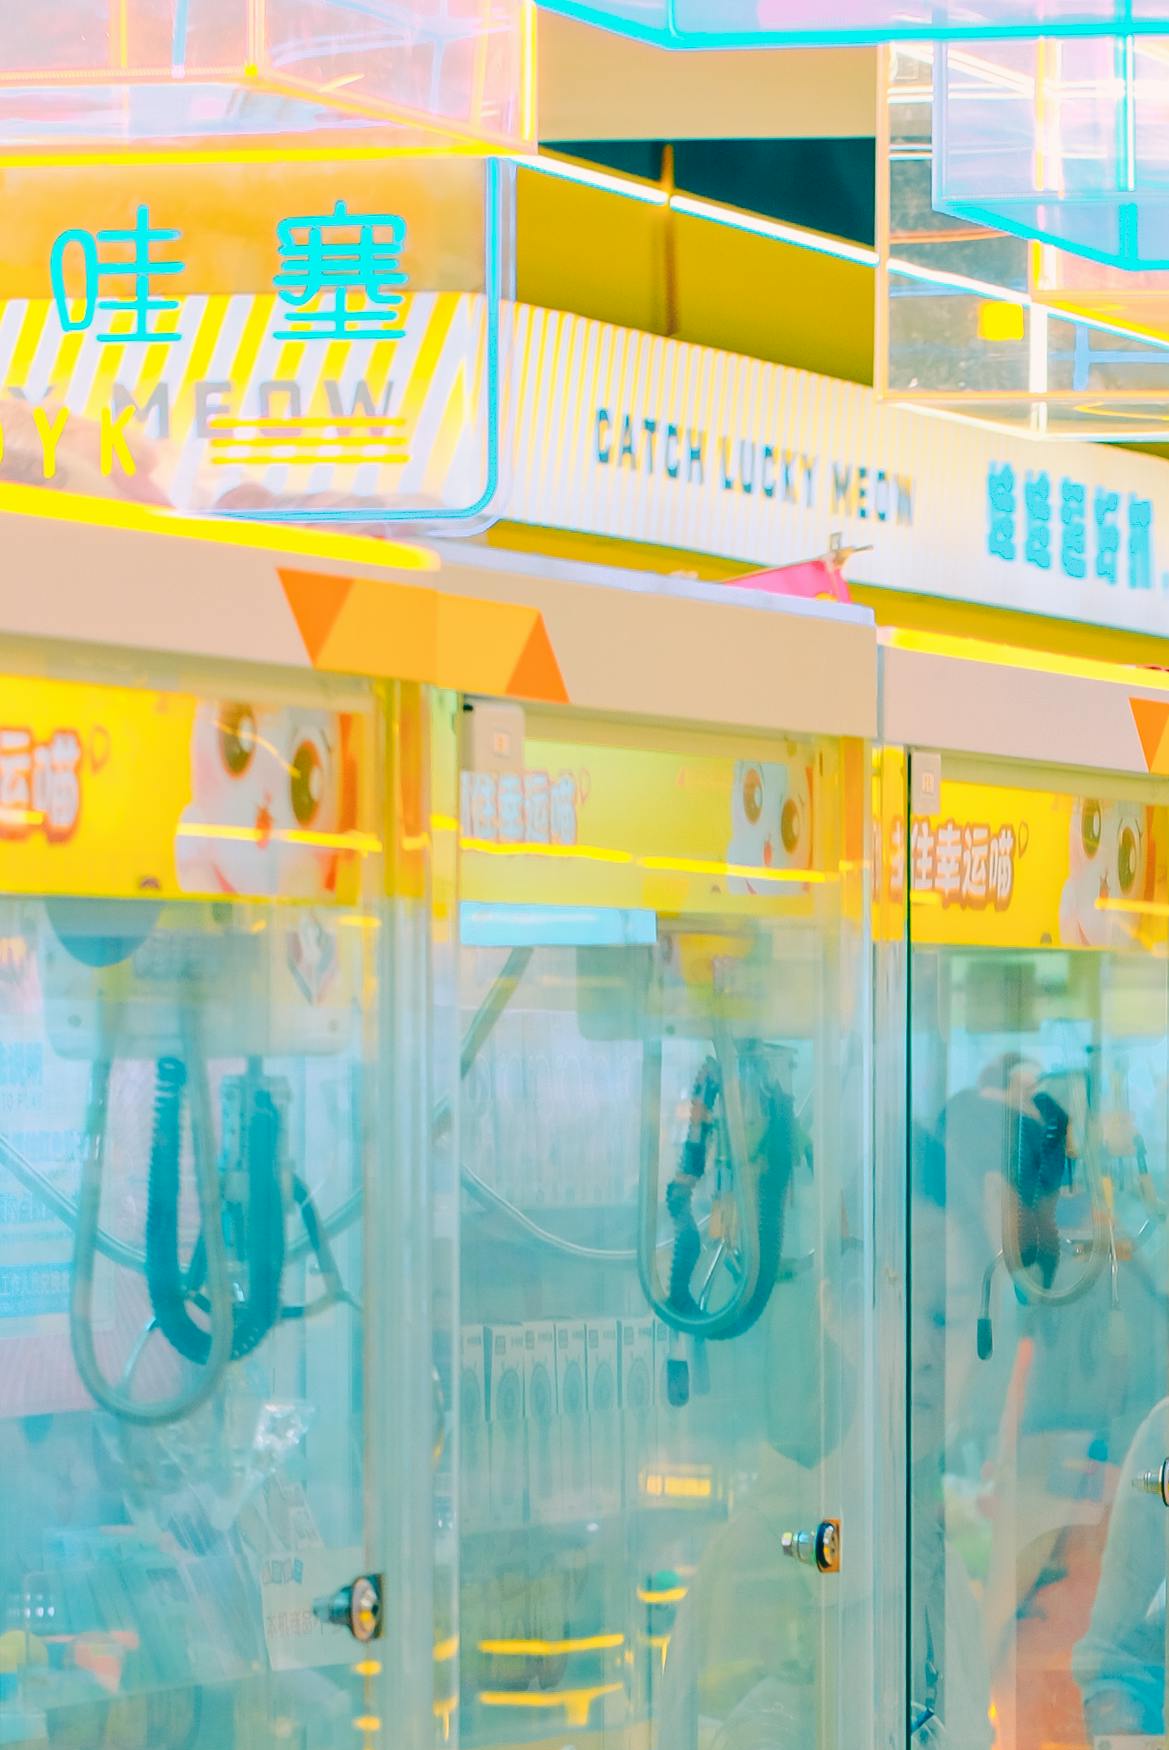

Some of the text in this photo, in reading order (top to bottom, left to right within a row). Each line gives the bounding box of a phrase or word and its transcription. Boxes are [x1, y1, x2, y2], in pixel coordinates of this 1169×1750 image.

[50, 201, 409, 342] 哇塞
[0, 405, 138, 478] YK
[112, 380, 395, 442] MEOW
[596, 408, 914, 526] CATCH LUCKY MEOW
